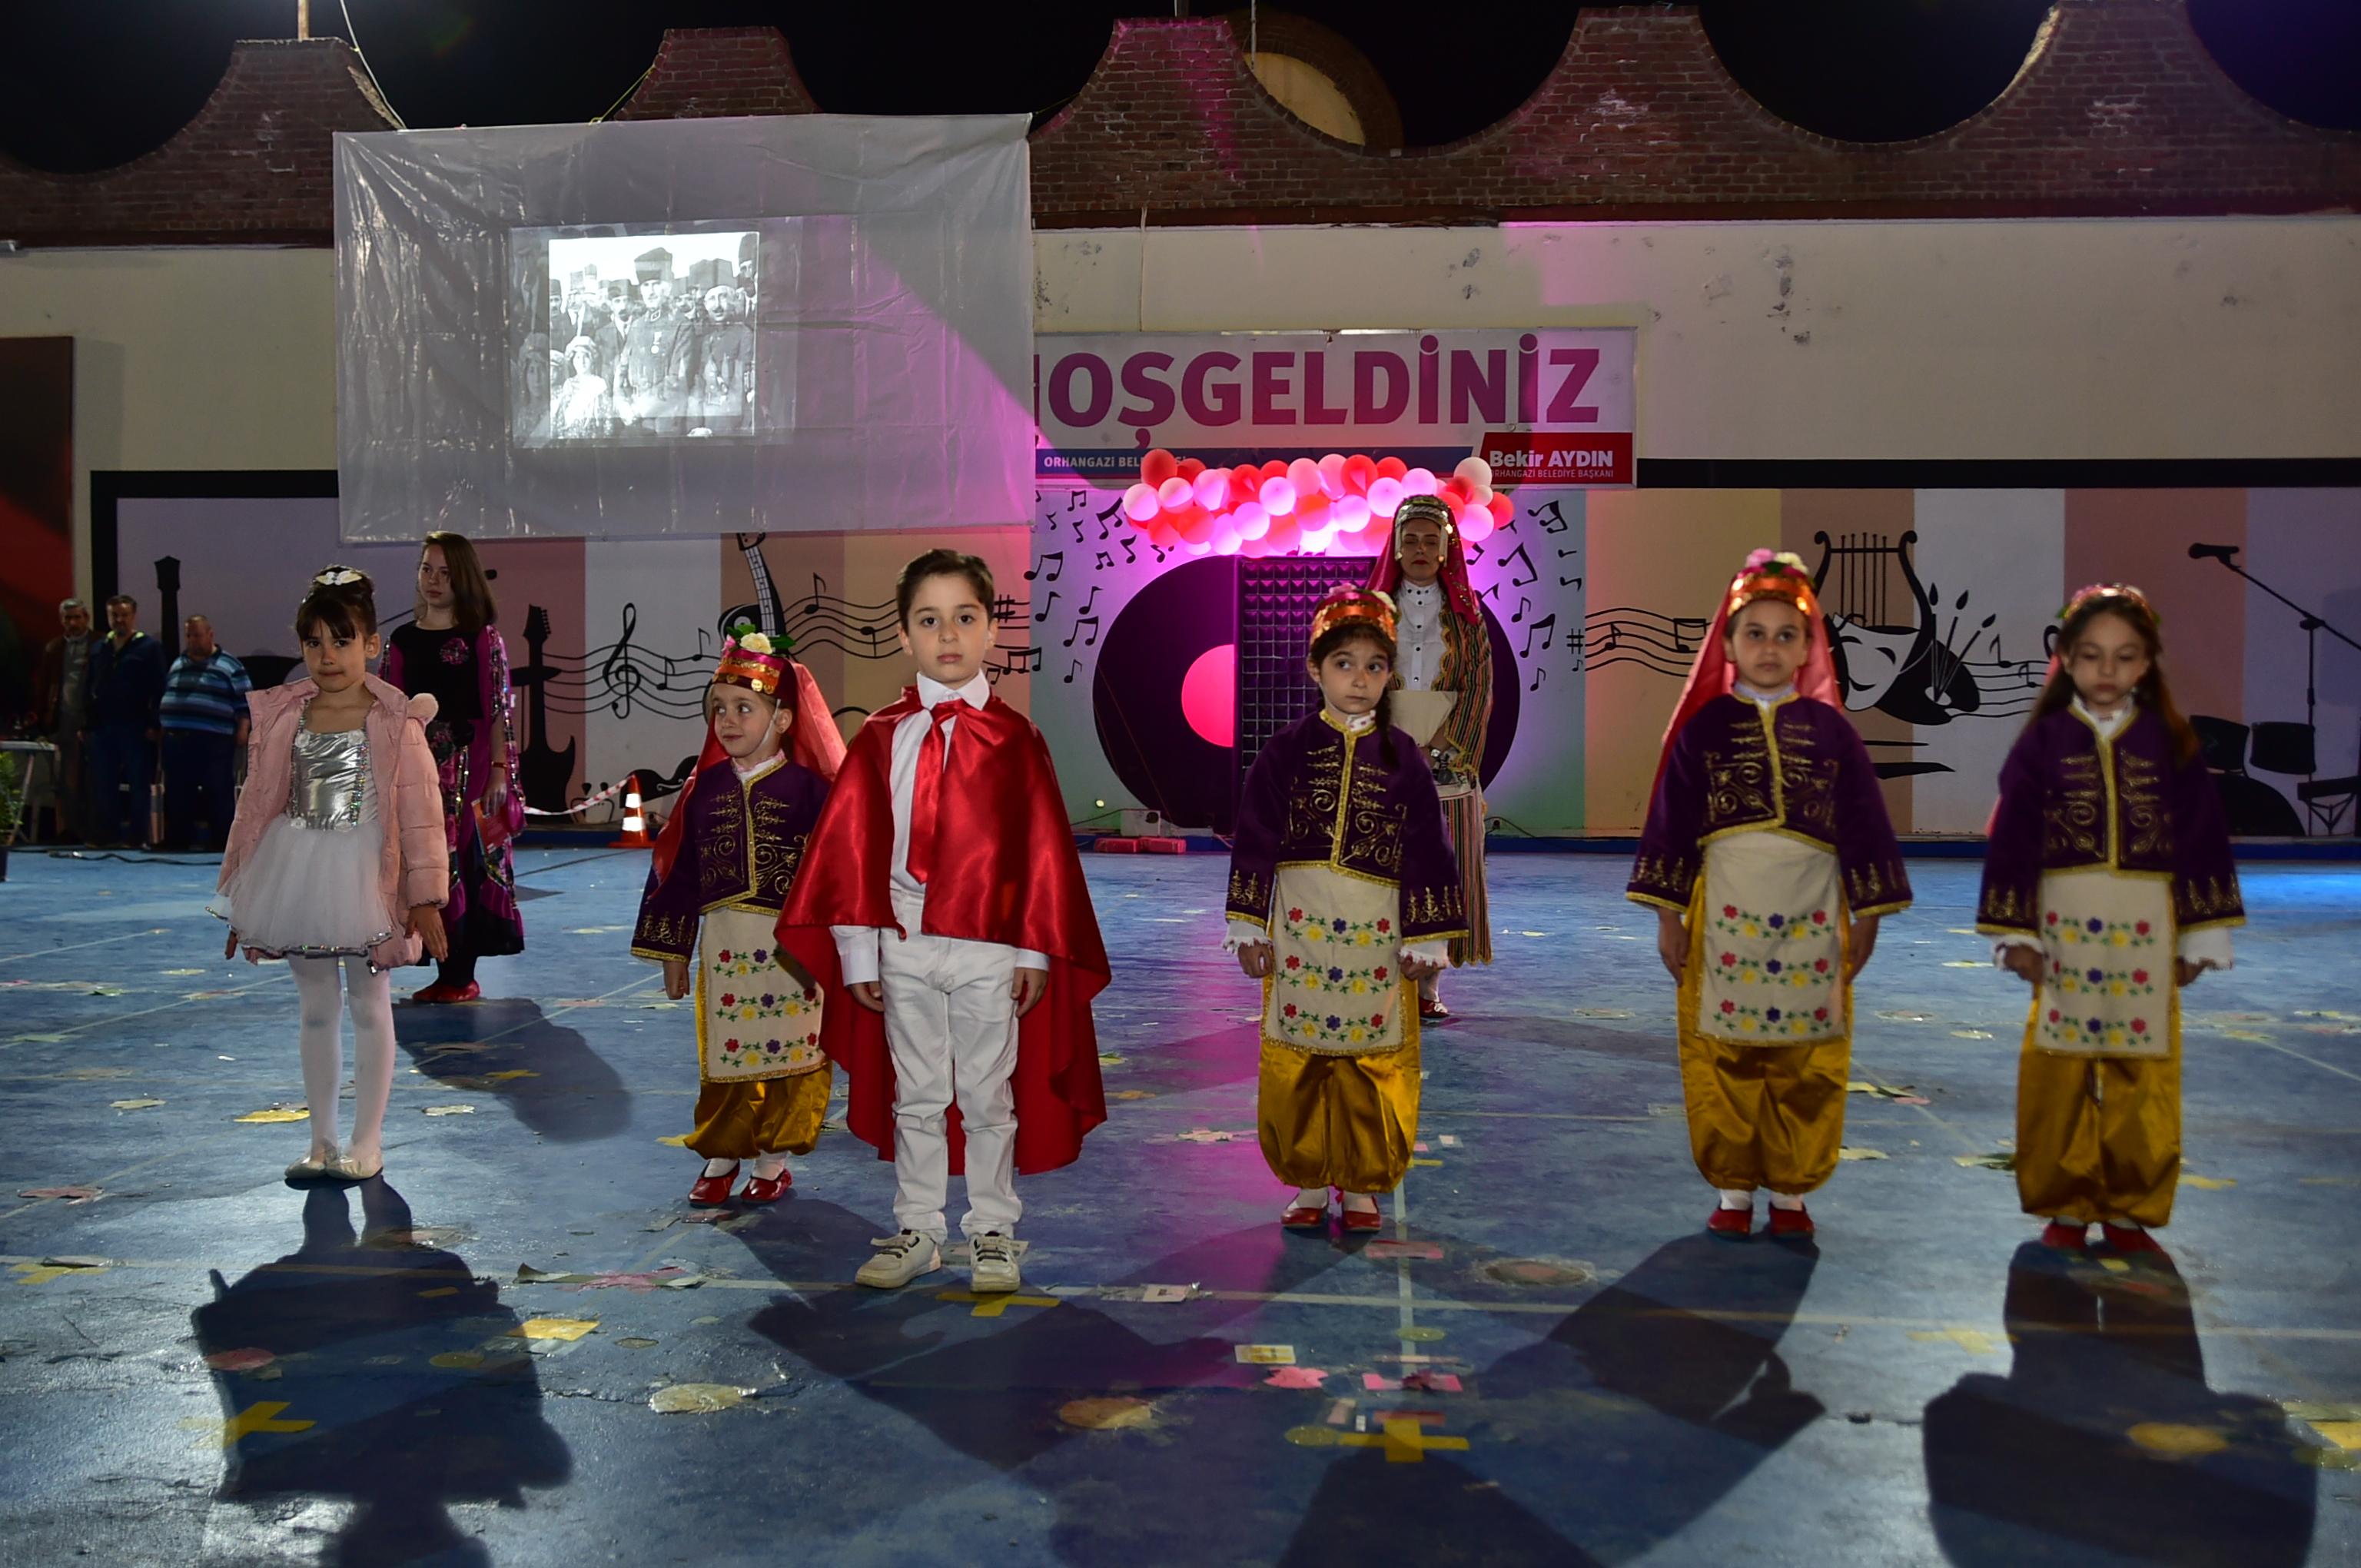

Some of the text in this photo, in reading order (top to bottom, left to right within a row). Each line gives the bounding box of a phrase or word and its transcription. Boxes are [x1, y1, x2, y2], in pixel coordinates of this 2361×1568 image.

[1034, 334, 1600, 448] OŞGELDİNİZ
[1044, 457, 1114, 467] ORHANGAZİ
[1489, 450, 1613, 467] Bekir AYDIN
[1537, 468, 1576, 478] BELEDİYE
[1578, 469, 1614, 480] BAŞKANI
